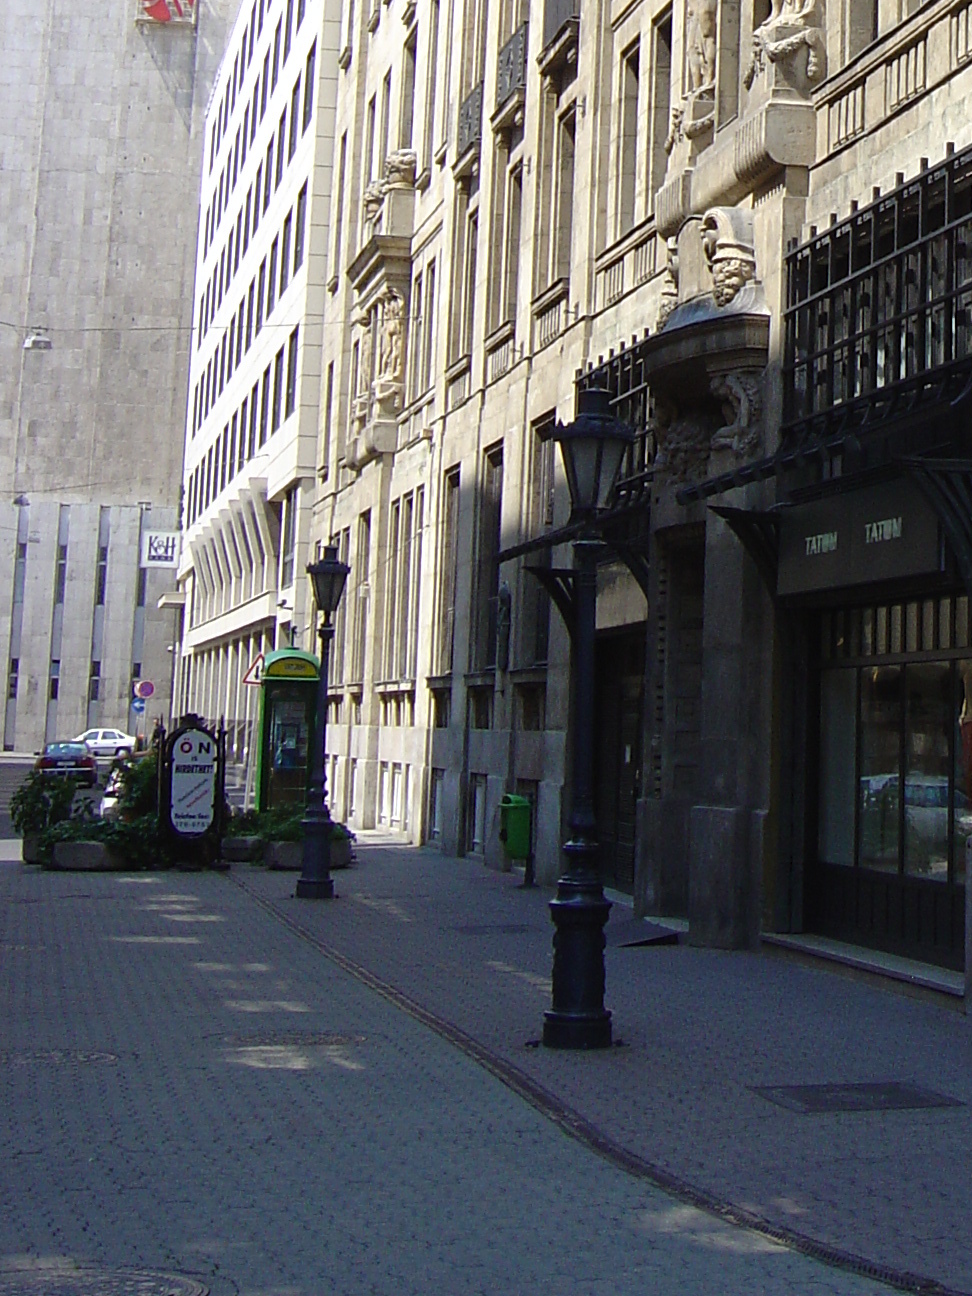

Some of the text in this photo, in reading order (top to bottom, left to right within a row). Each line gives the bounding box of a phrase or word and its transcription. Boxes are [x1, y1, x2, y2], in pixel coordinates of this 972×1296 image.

[149, 536, 175, 555] K&H
[805, 517, 902, 555] TATUM TATUM
